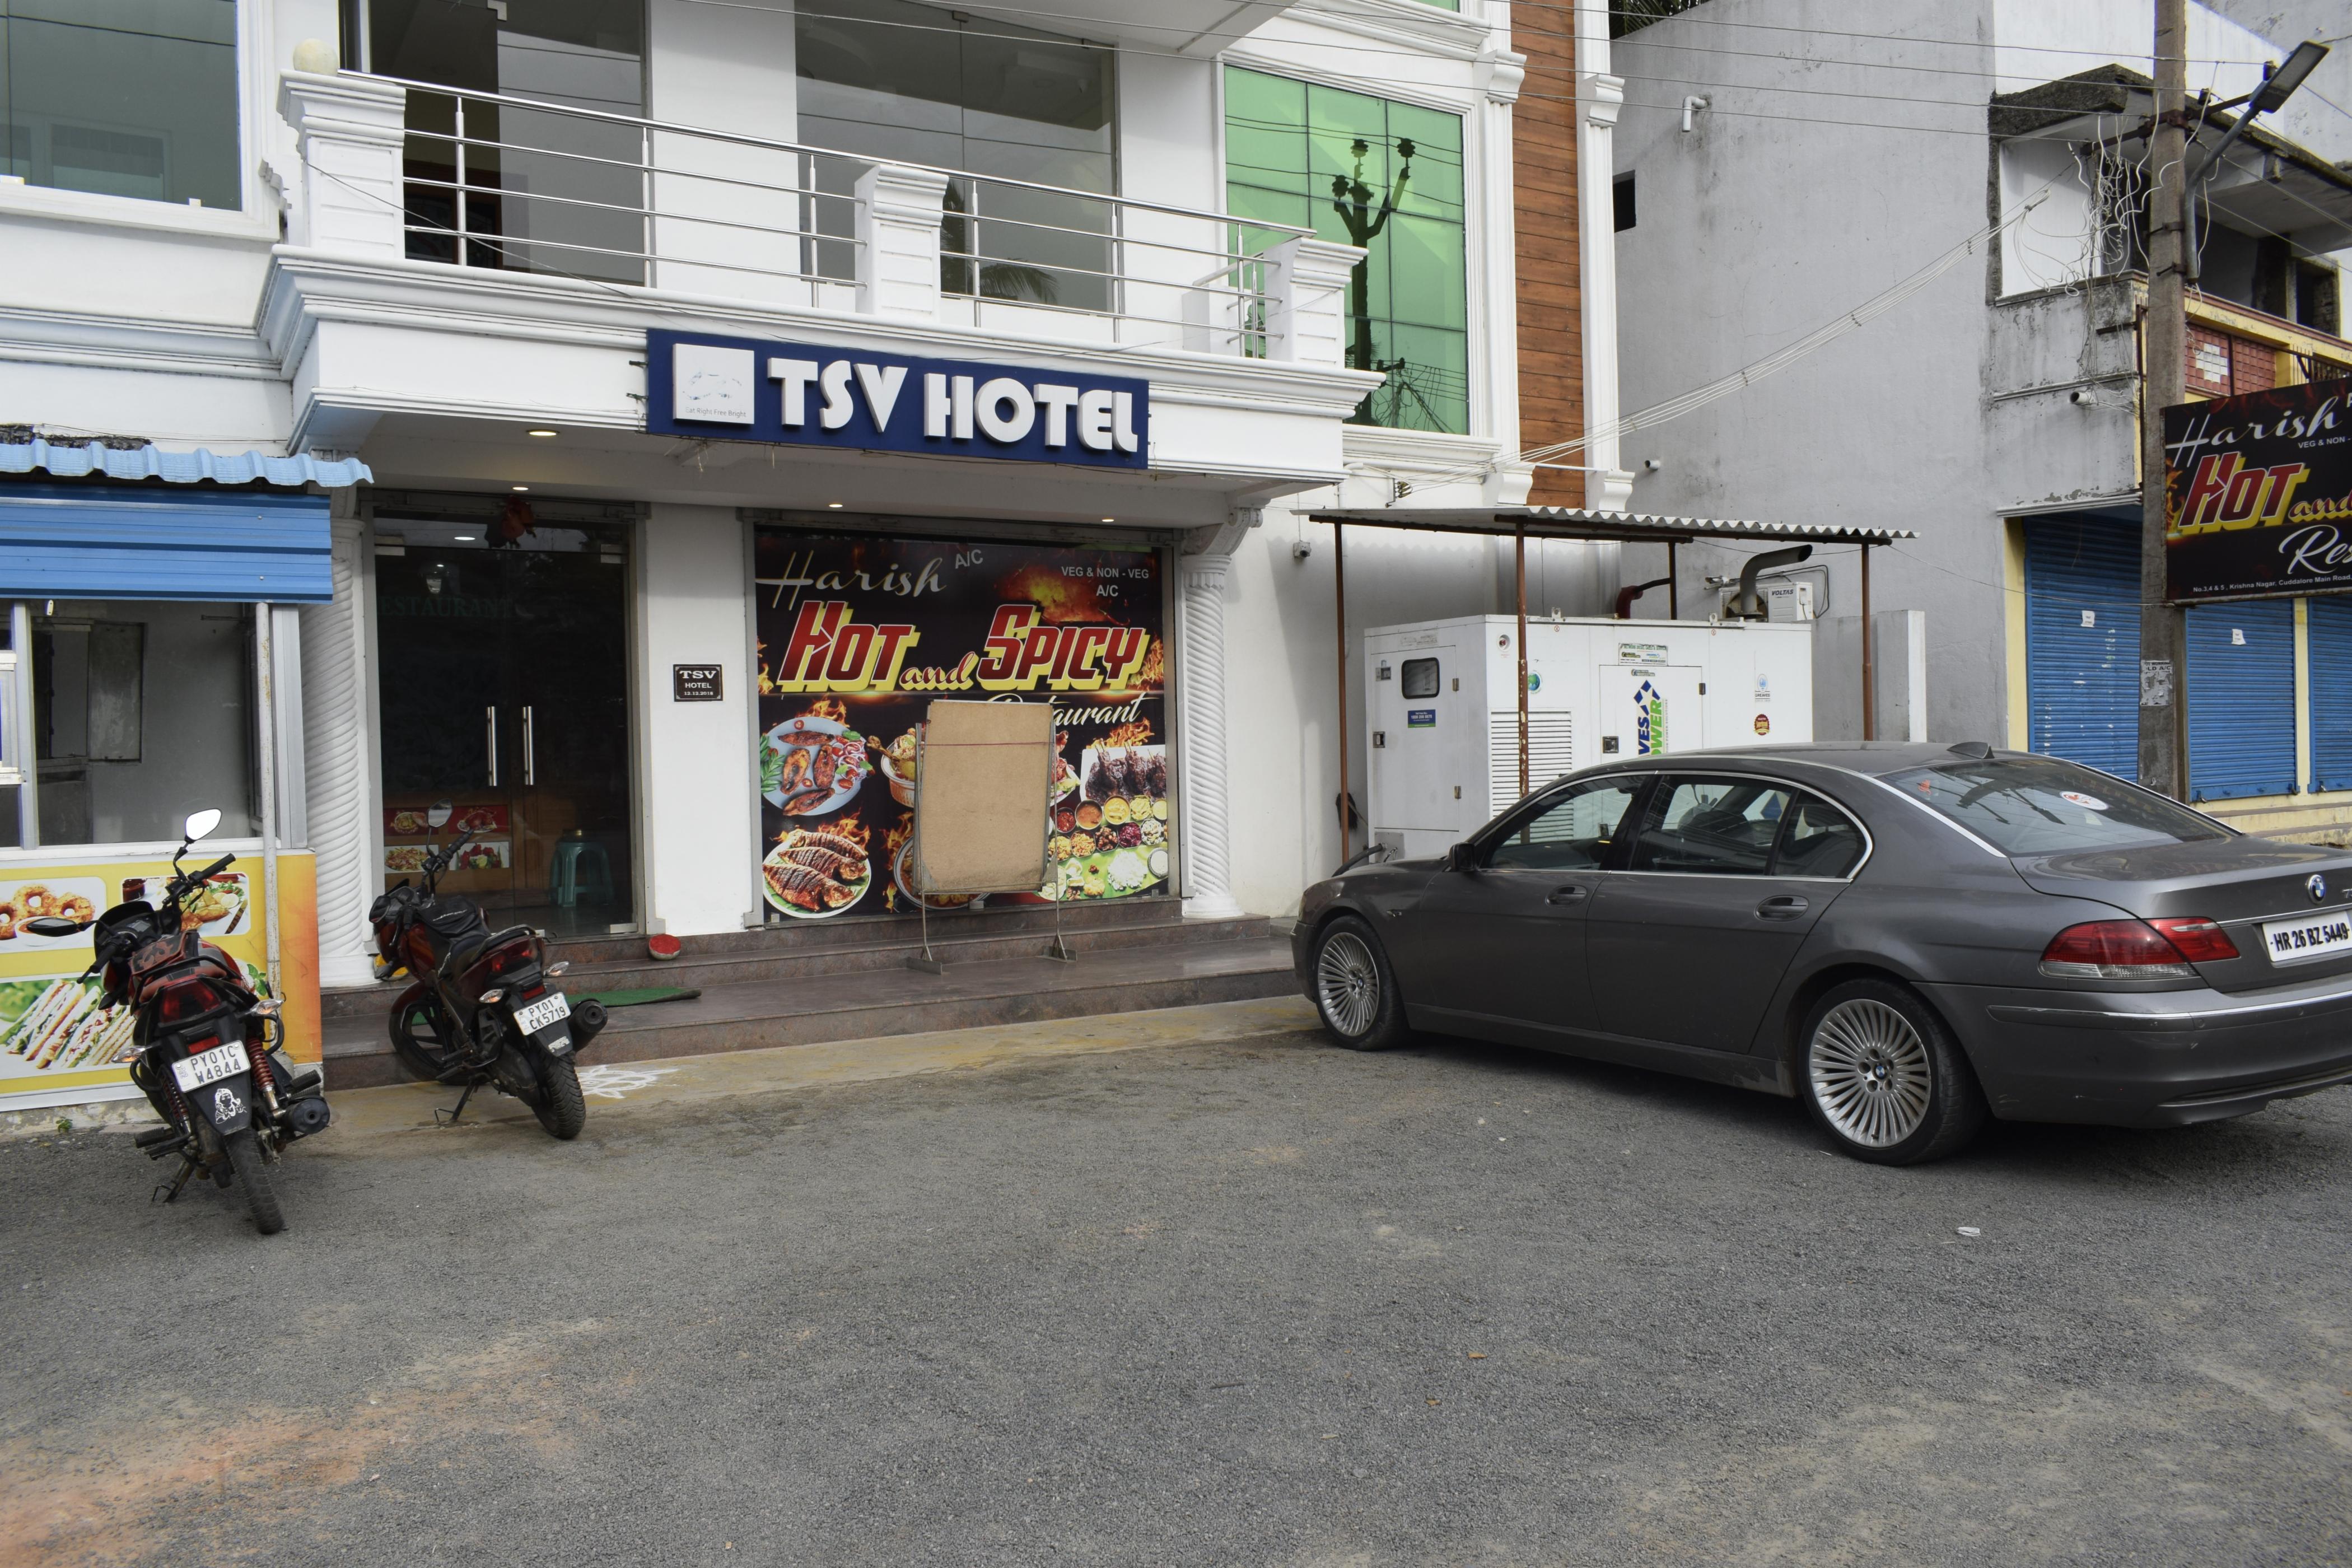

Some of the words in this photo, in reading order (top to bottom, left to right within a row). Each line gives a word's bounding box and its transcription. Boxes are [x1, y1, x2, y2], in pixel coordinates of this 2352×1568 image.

[728, 410, 746, 418] Bright
[767, 357, 908, 433] TSV
[923, 372, 1138, 452] HOTEL
[2166, 396, 2342, 468] Harish
[2326, 436, 2345, 445] NON
[2177, 451, 2311, 534] HOT
[755, 550, 946, 611] Harish
[955, 549, 983, 569] A/C
[1061, 566, 1084, 577] VEG
[1086, 567, 1094, 577] &
[1096, 567, 1119, 578] NON
[1128, 568, 1149, 578] VEG
[2279, 577, 2313, 586] Cuddalore
[1096, 585, 1118, 597] A/C
[379, 595, 512, 618] ESTAURANT
[776, 600, 921, 692] HOT
[899, 651, 981, 691] and
[977, 604, 1150, 692] SPICY
[679, 670, 716, 679] TSV
[1650, 699, 1662, 755] WER
[2274, 932, 2292, 951] HR
[2292, 930, 2307, 949] 26
[2306, 927, 2323, 946] BZ
[2322, 922, 2349, 944] 5449
[528, 999, 554, 1017] PY01
[529, 1006, 566, 1030] CK5719
[190, 1046, 236, 1071] PY01C
[195, 1058, 241, 1084] W4844
